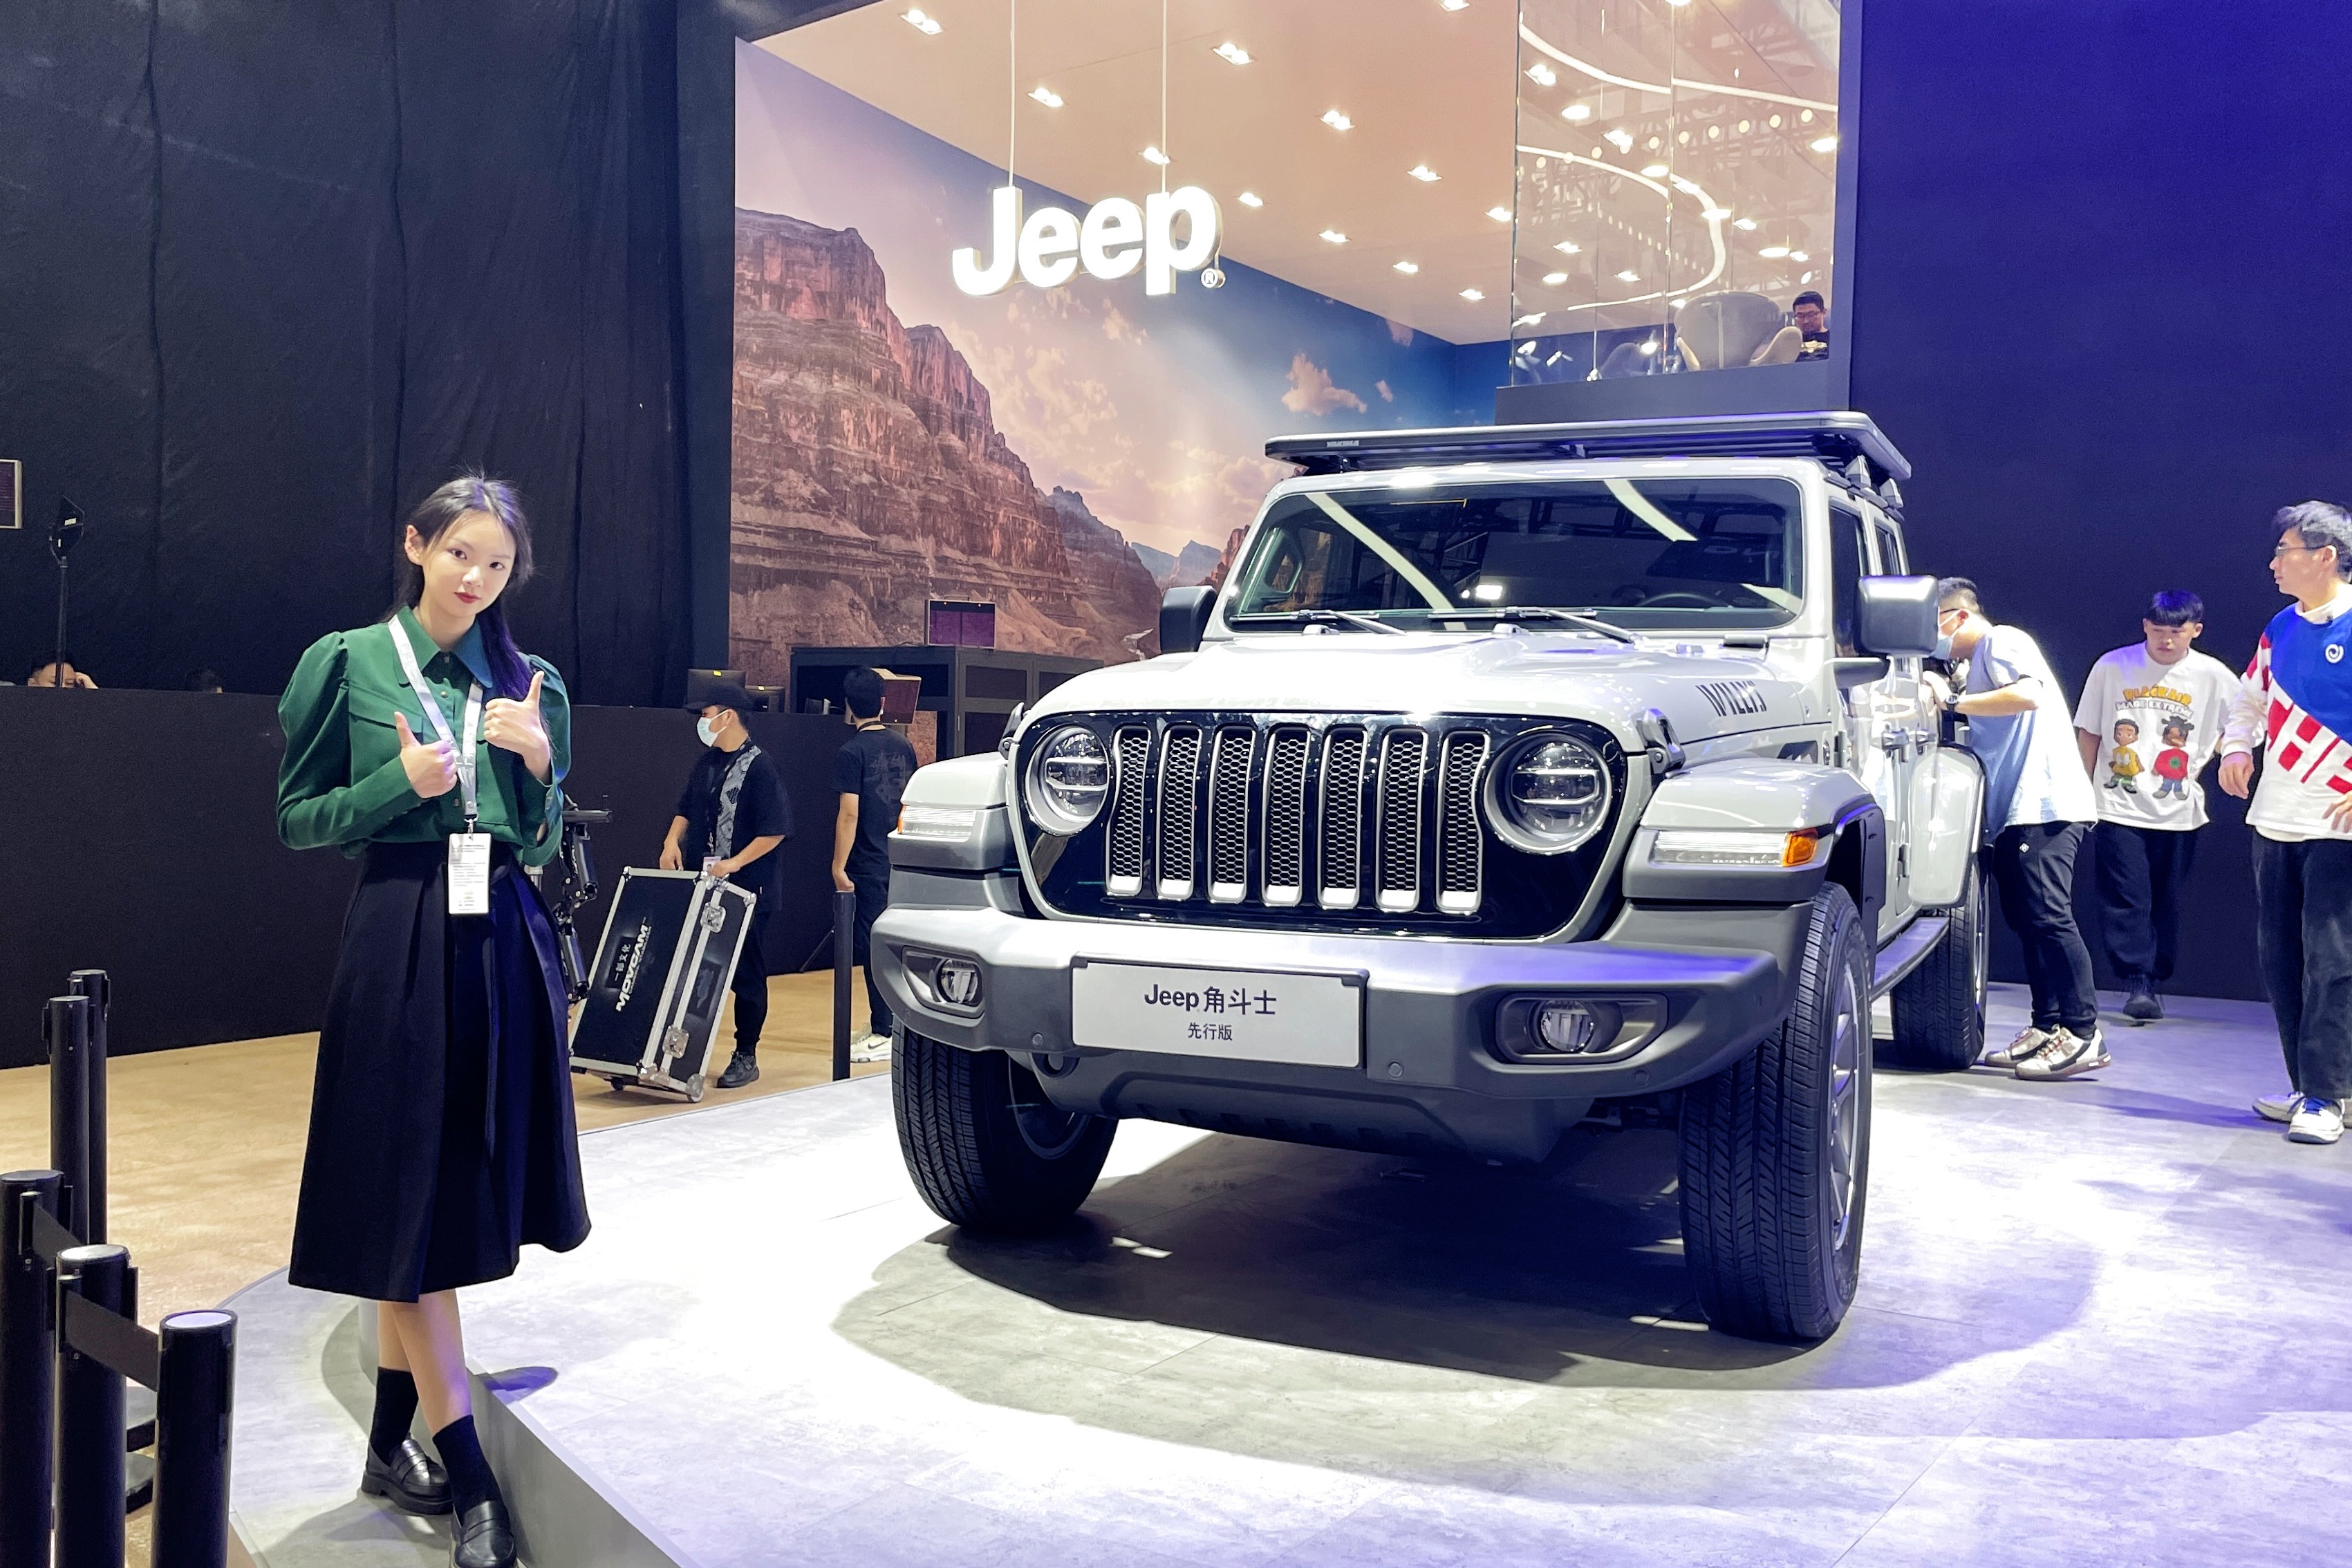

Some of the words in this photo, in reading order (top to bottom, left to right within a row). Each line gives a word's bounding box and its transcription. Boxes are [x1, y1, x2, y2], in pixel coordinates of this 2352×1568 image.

[952, 185, 1221, 297] Jeep
[615, 924, 648, 1012] MOVCAM
[1144, 984, 1200, 1011] Jeep
[1203, 986, 1277, 1016] 角斗士
[1188, 1022, 1233, 1041] 先行版
